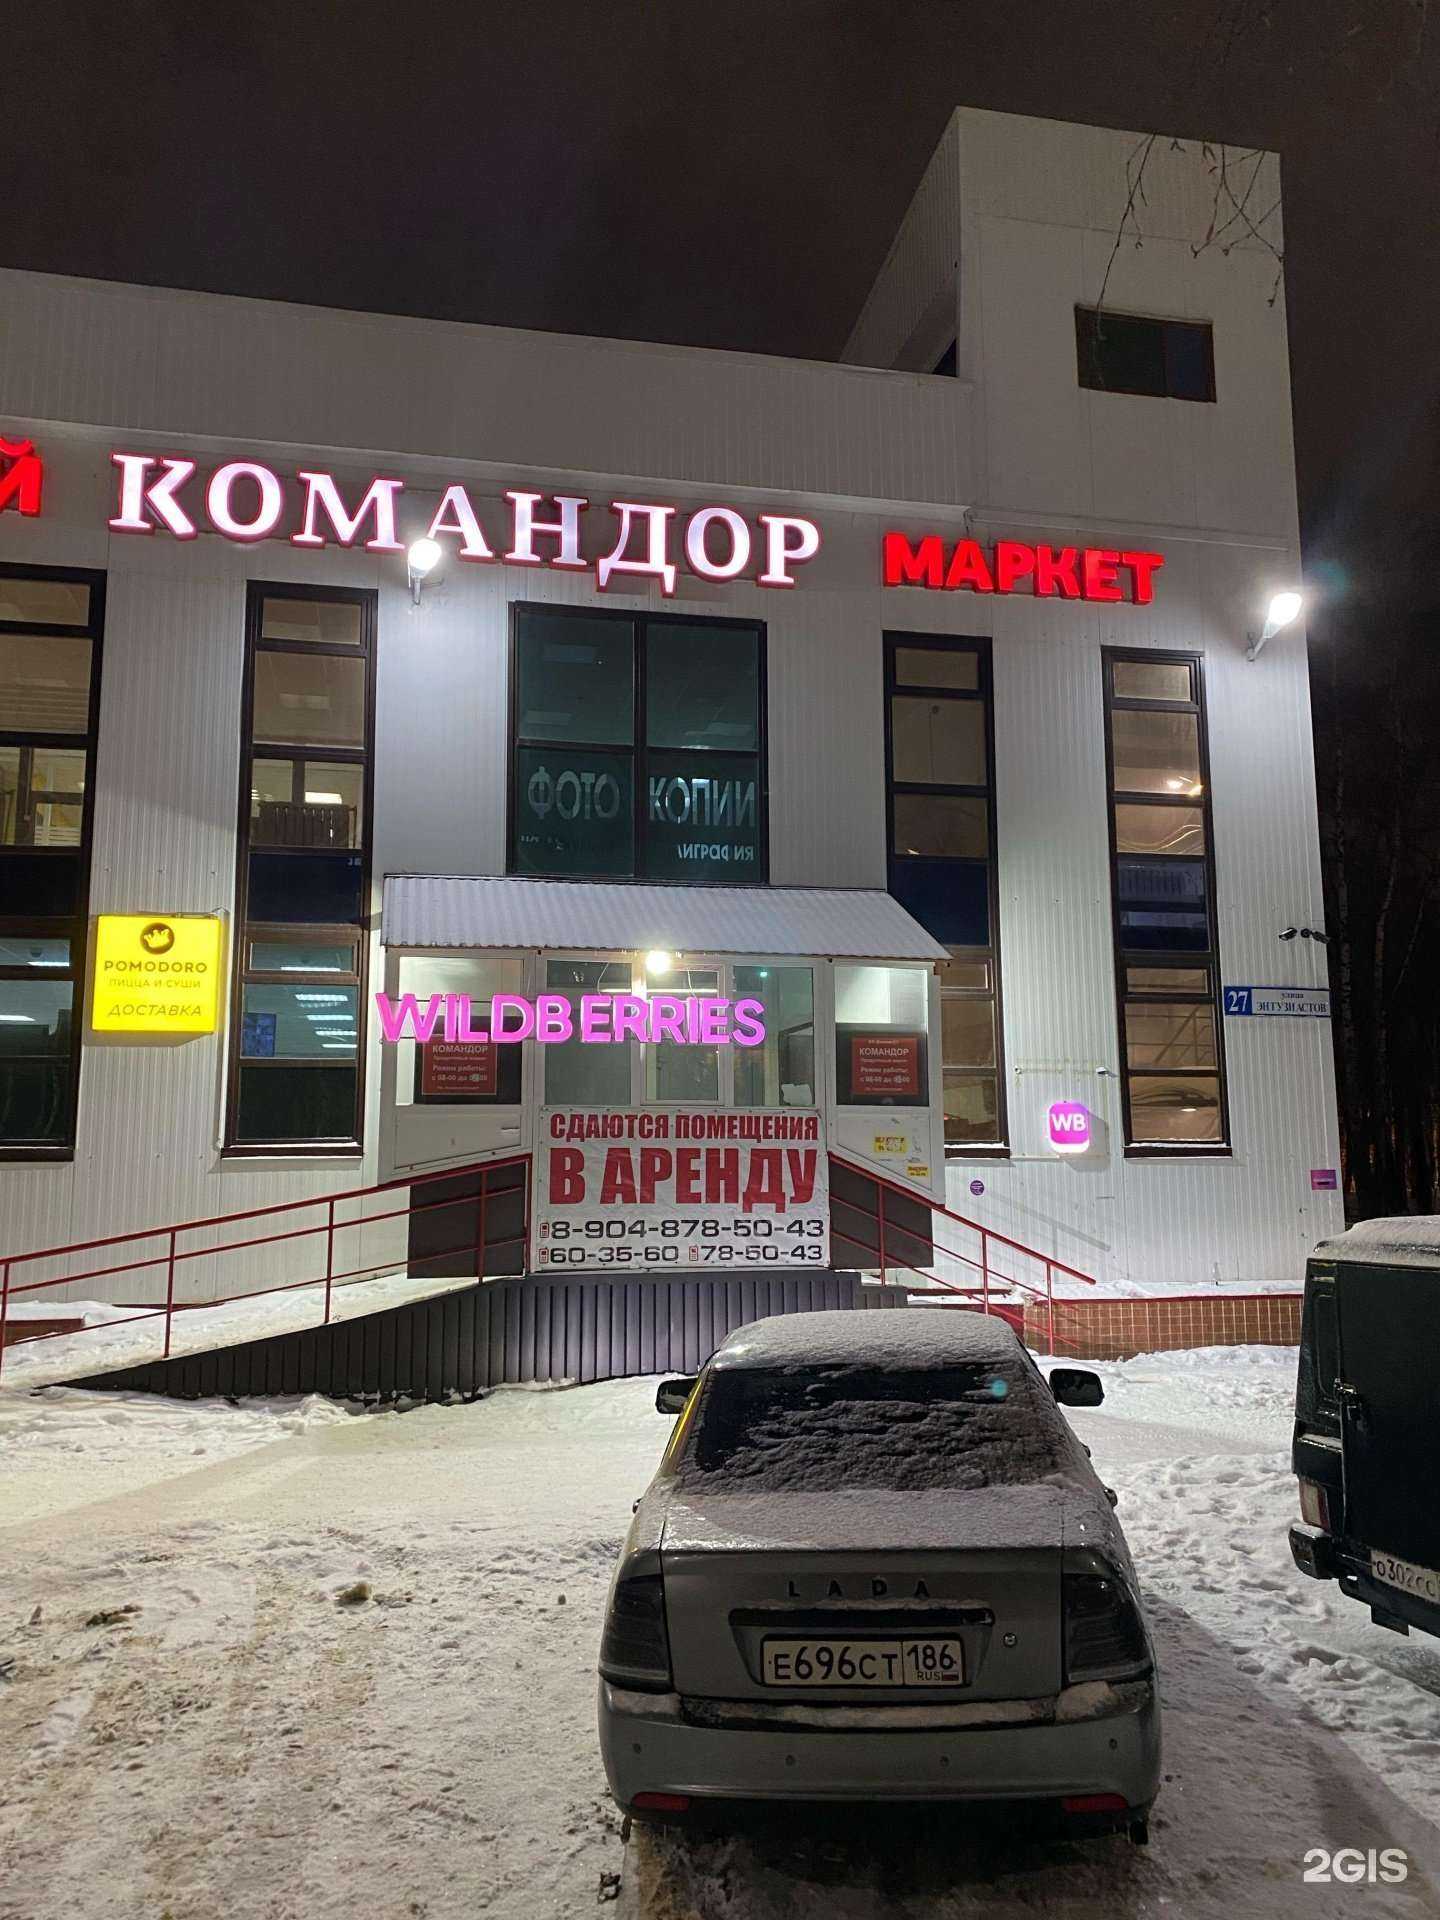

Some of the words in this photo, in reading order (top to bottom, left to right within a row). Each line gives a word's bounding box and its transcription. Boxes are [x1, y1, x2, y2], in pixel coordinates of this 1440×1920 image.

[107, 452, 822, 598] КОМАНДОР
[883, 532, 1165, 605] МАРКЕТ
[528, 766, 621, 820] ФОТО
[649, 777, 755, 827] КОПИИ
[104, 961, 208, 973] POMODORO
[109, 978, 151, 988] ПИЦЦА
[154, 979, 162, 988] И
[166, 979, 201, 989] СУШИ
[107, 1003, 202, 1017] ДОСТАВКА
[1228, 991, 1249, 1012] 27
[1256, 1001, 1327, 1013] ЭНТУЗИАСТОВ
[375, 992, 766, 1047] WILDBERRIES
[432, 1045, 488, 1054] КОМАНДОР
[859, 1047, 910, 1056] КОМАНДОР
[550, 1114, 669, 1142] СДАЮТСЯ
[675, 1115, 818, 1143] ПОМЕЩЕНИЯ
[1052, 1113, 1087, 1132] WB
[549, 1147, 586, 1205] В
[600, 1147, 818, 1213] АРЕНДУ
[551, 1219, 825, 1240] 8-904-878-50-43
[550, 1246, 679, 1263] 60-35-60
[700, 1245, 823, 1261] 78-50-43
[788, 1579, 929, 1597] LADA
[774, 1646, 898, 1680] Е696СТ
[907, 1644, 955, 1671] 186
[917, 1671, 942, 1682] RUS
